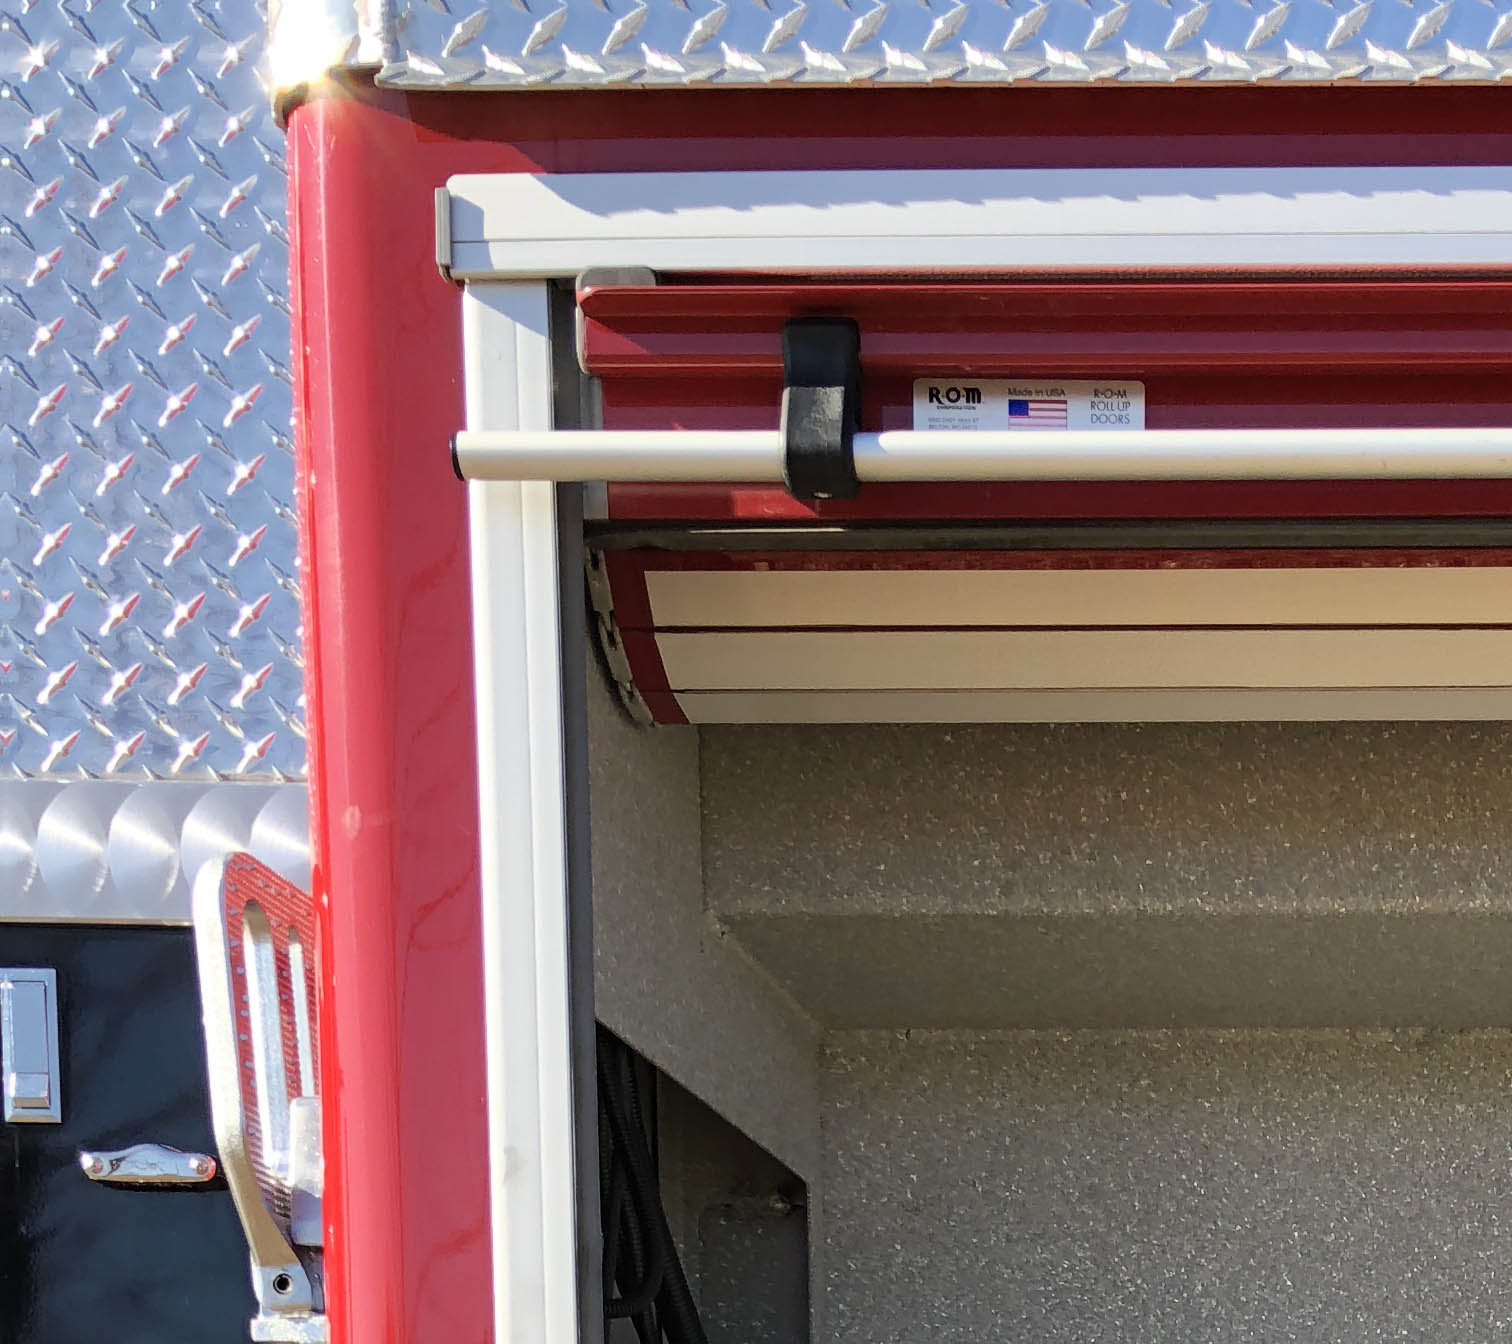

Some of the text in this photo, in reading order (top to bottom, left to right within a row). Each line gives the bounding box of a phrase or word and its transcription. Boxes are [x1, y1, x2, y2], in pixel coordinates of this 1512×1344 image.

[1007, 387, 1066, 397] Made in USA
[1090, 401, 1131, 412] ROLL UP
[1090, 413, 1131, 425] DOORS
